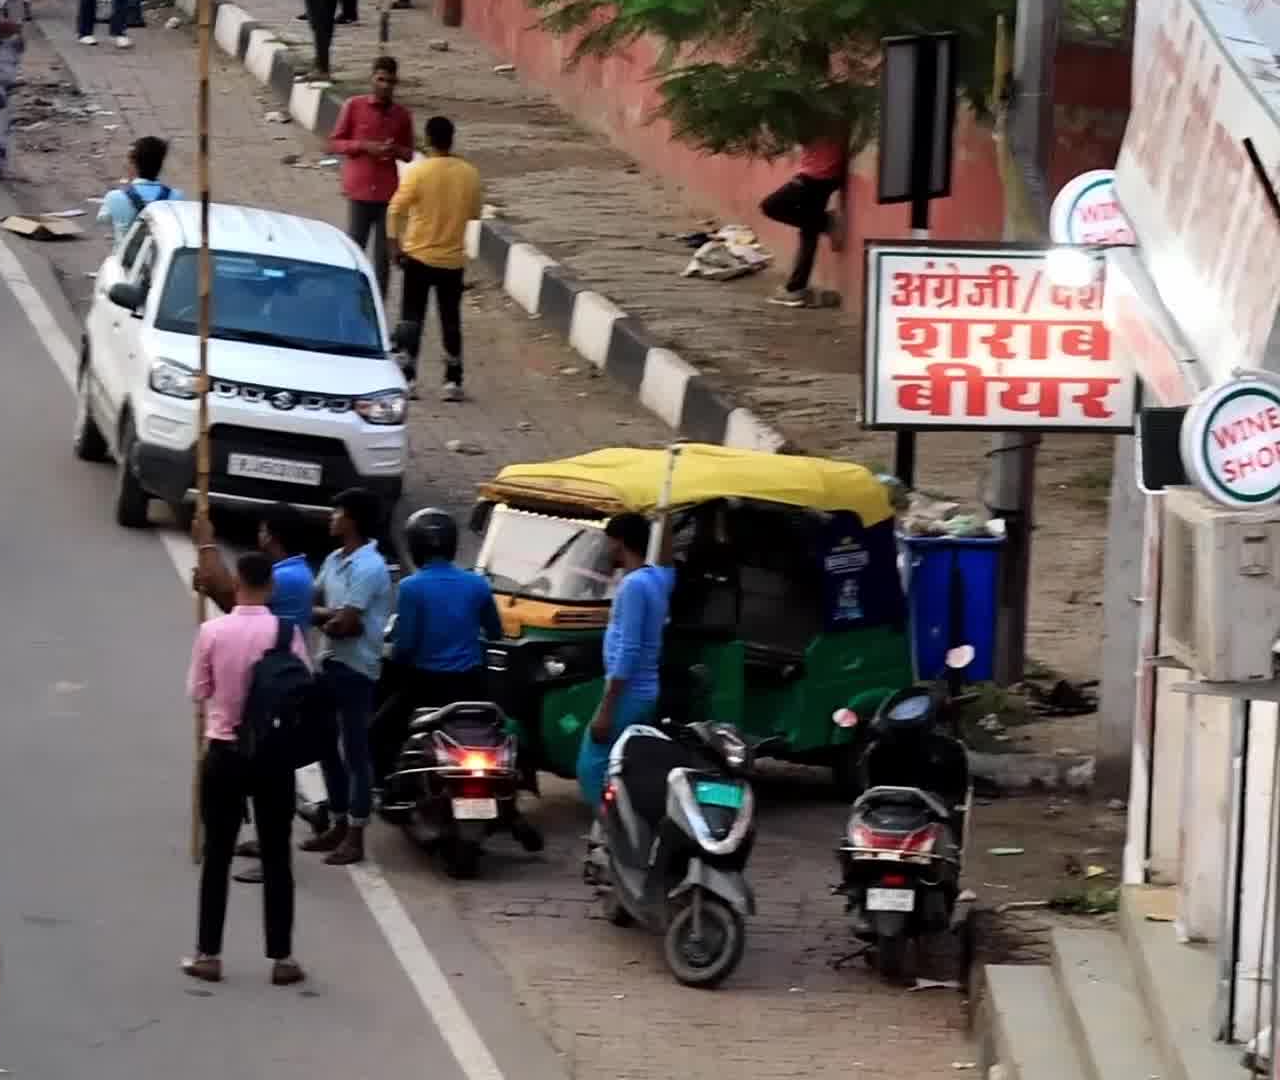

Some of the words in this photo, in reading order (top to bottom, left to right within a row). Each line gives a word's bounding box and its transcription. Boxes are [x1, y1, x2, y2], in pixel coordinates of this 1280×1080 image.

[896, 317, 1111, 360] शराब
[891, 362, 1121, 419] बीयर
[1210, 407, 1280, 449] WINE
